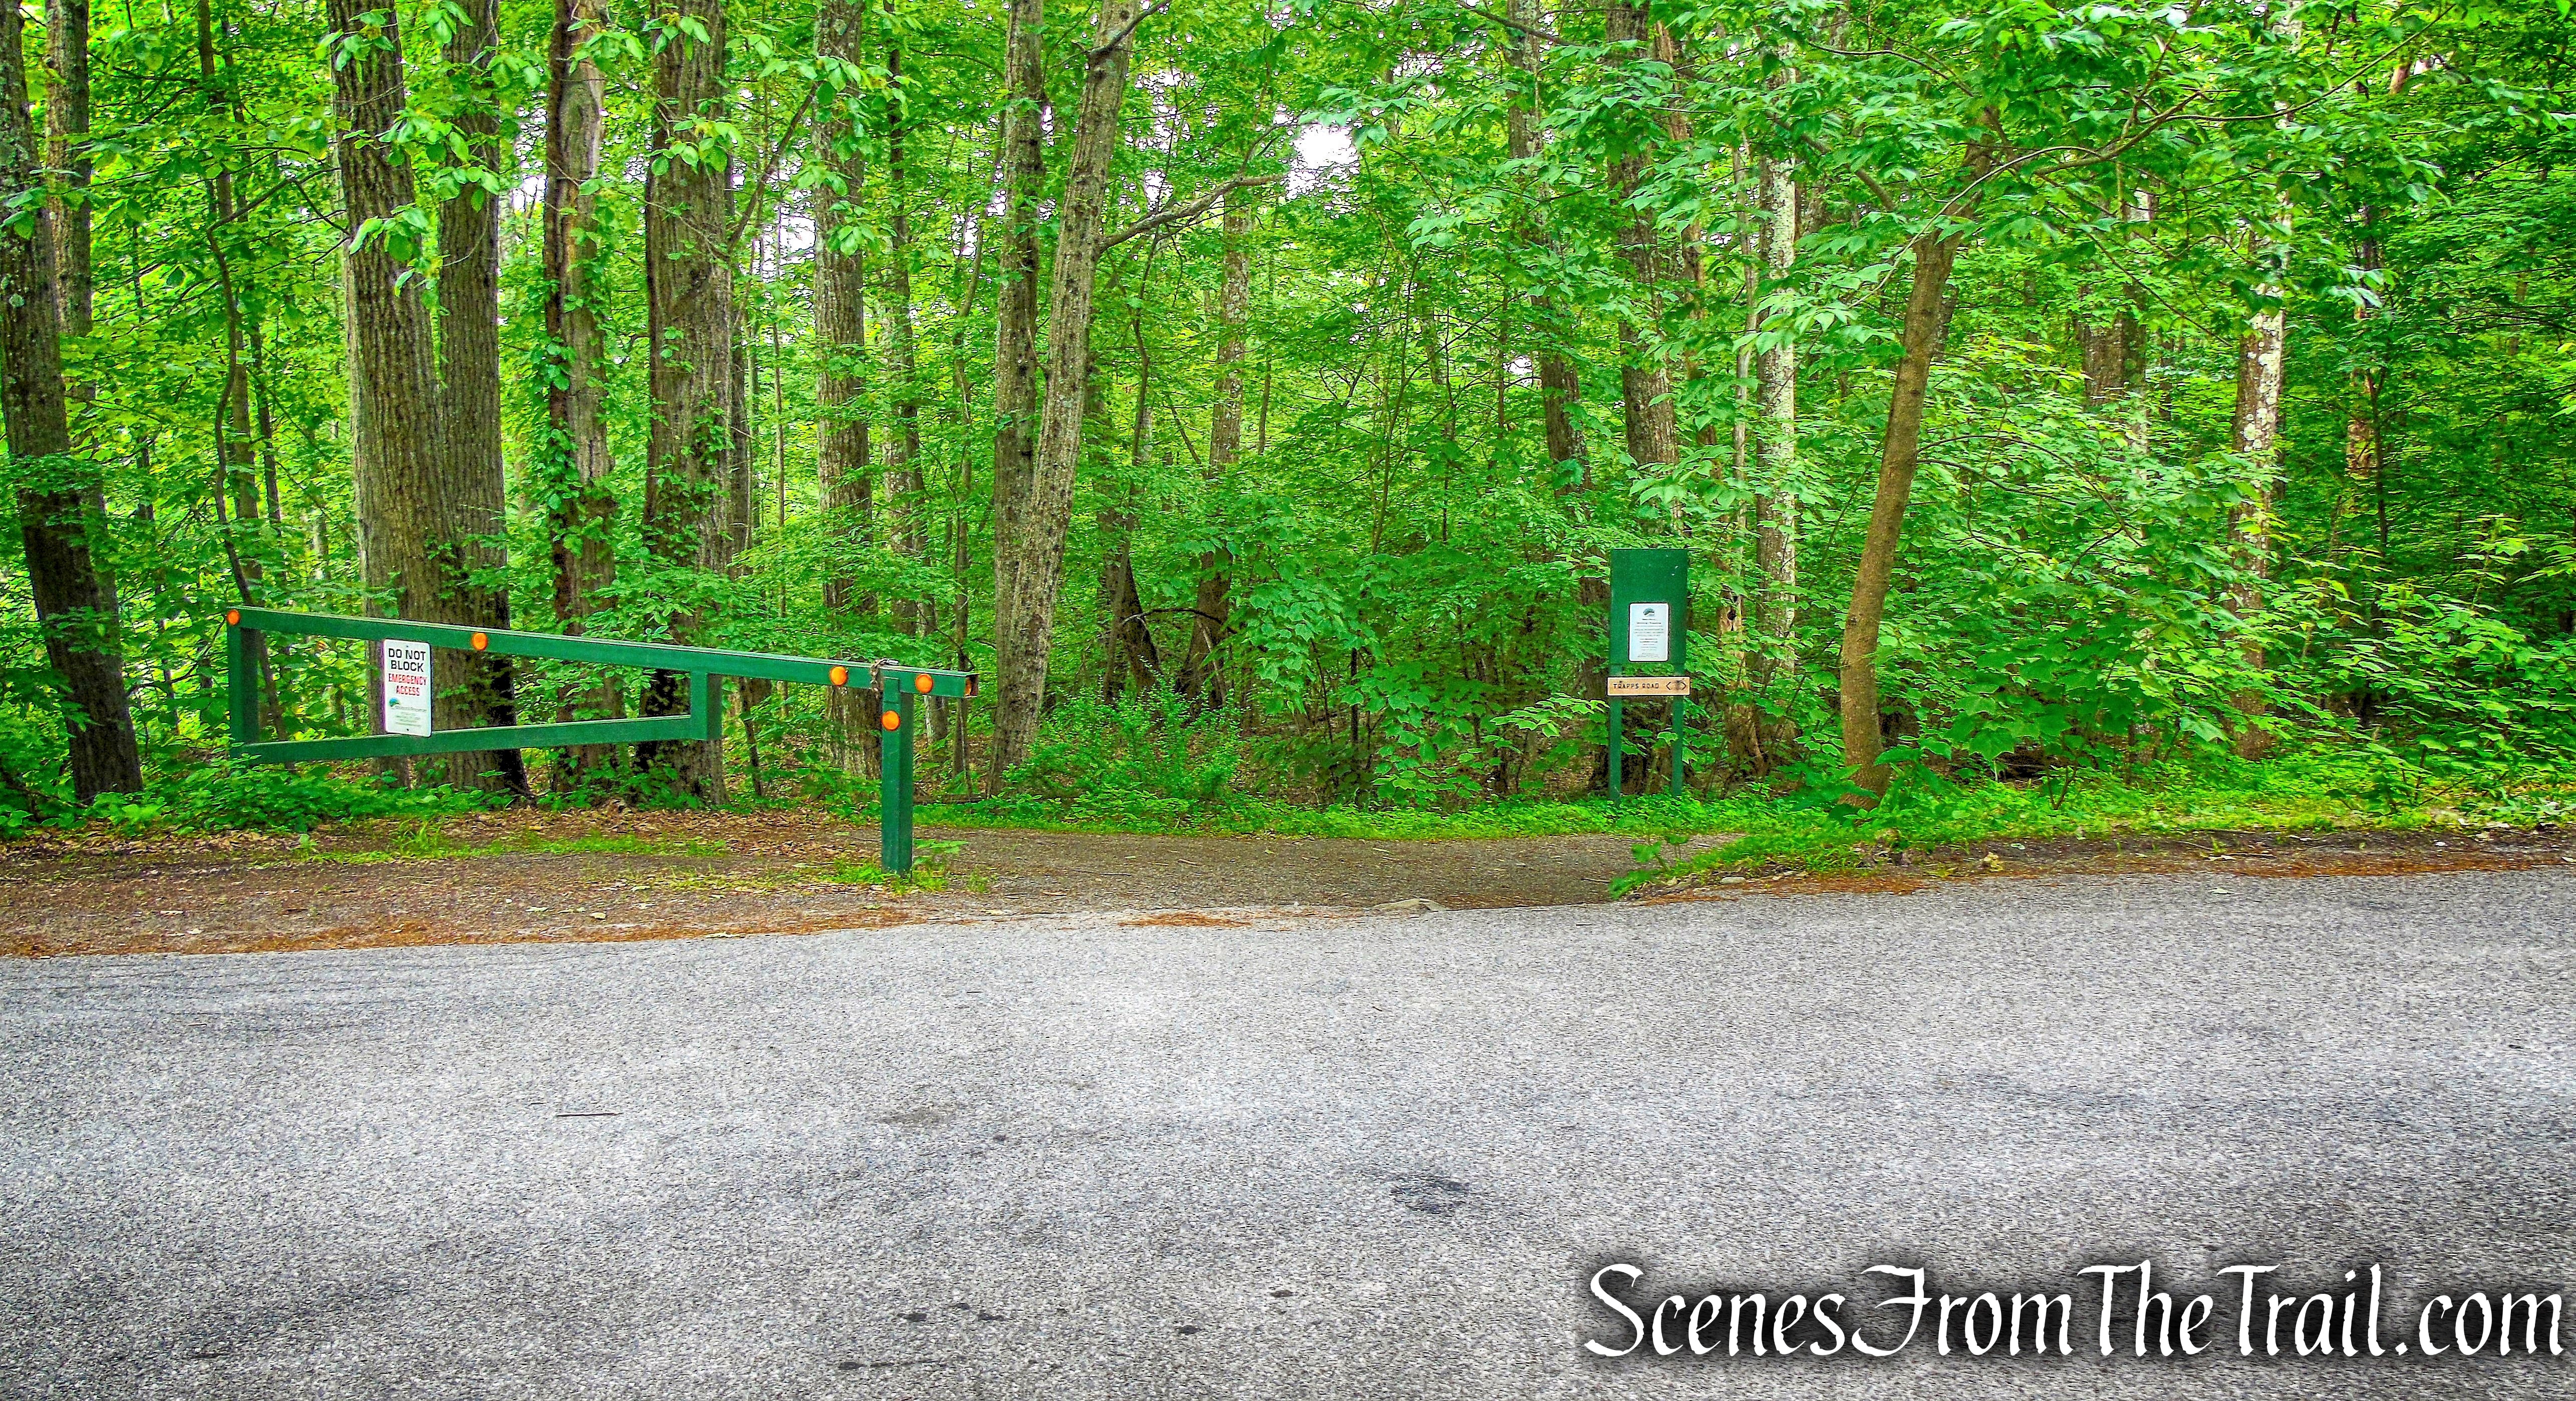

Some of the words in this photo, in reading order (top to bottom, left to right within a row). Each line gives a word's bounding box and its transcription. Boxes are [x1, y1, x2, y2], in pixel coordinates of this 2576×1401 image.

[388, 648, 402, 658] DO
[406, 650, 426, 661] NOT
[391, 660, 424, 672] BLOCK
[388, 673, 427, 685] EMERGENCY
[396, 685, 420, 696] ACCESS
